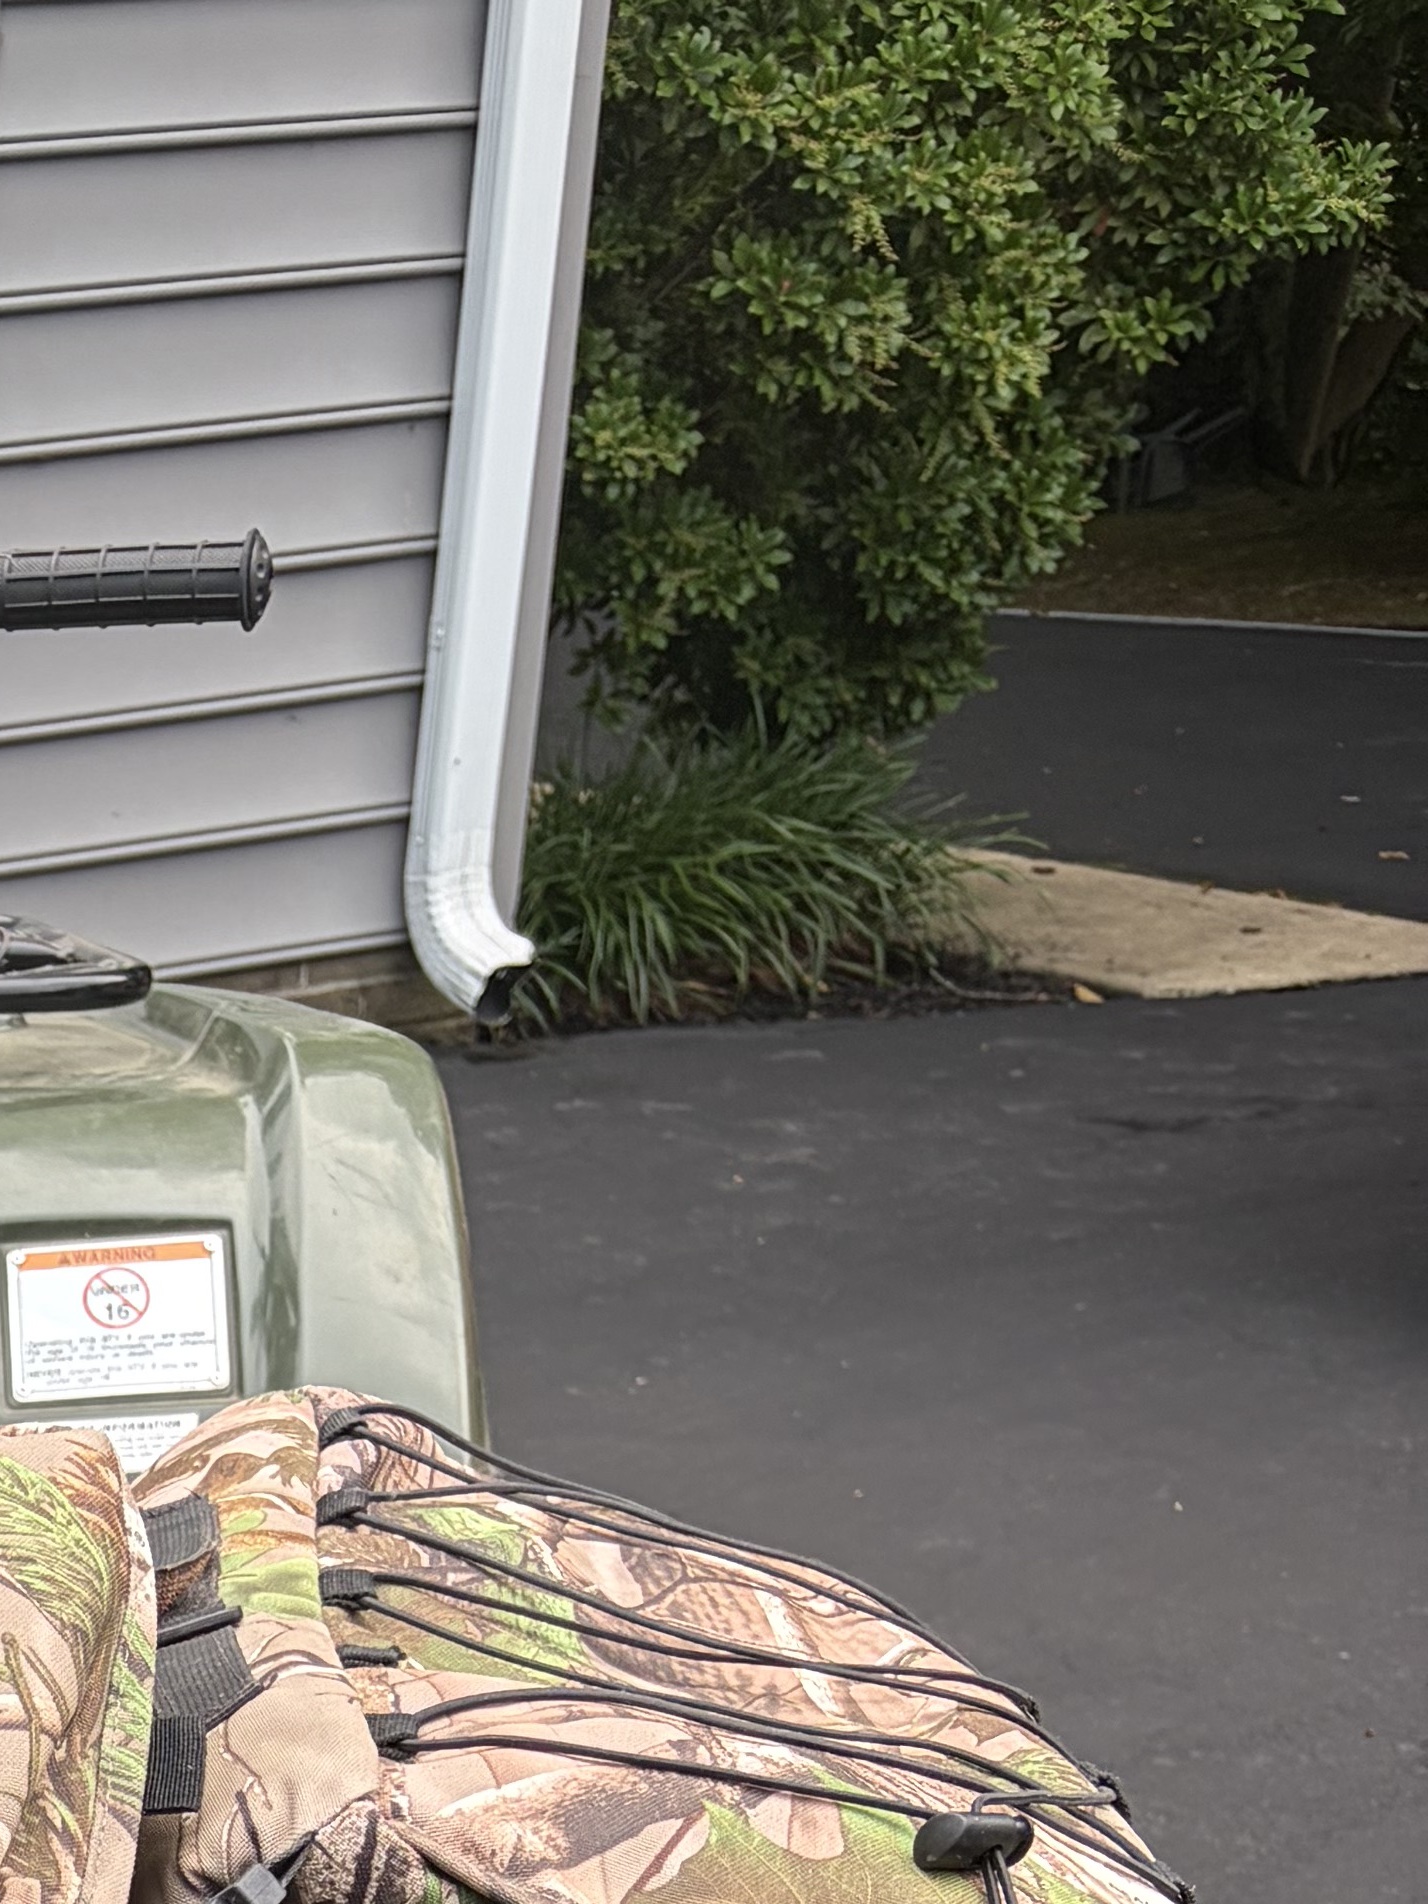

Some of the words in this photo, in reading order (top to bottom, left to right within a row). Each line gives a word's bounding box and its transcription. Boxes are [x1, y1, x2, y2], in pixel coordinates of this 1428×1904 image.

[74, 1246, 157, 1265] WARNING
[92, 1283, 140, 1297] UNDER
[106, 1303, 130, 1320] 16
